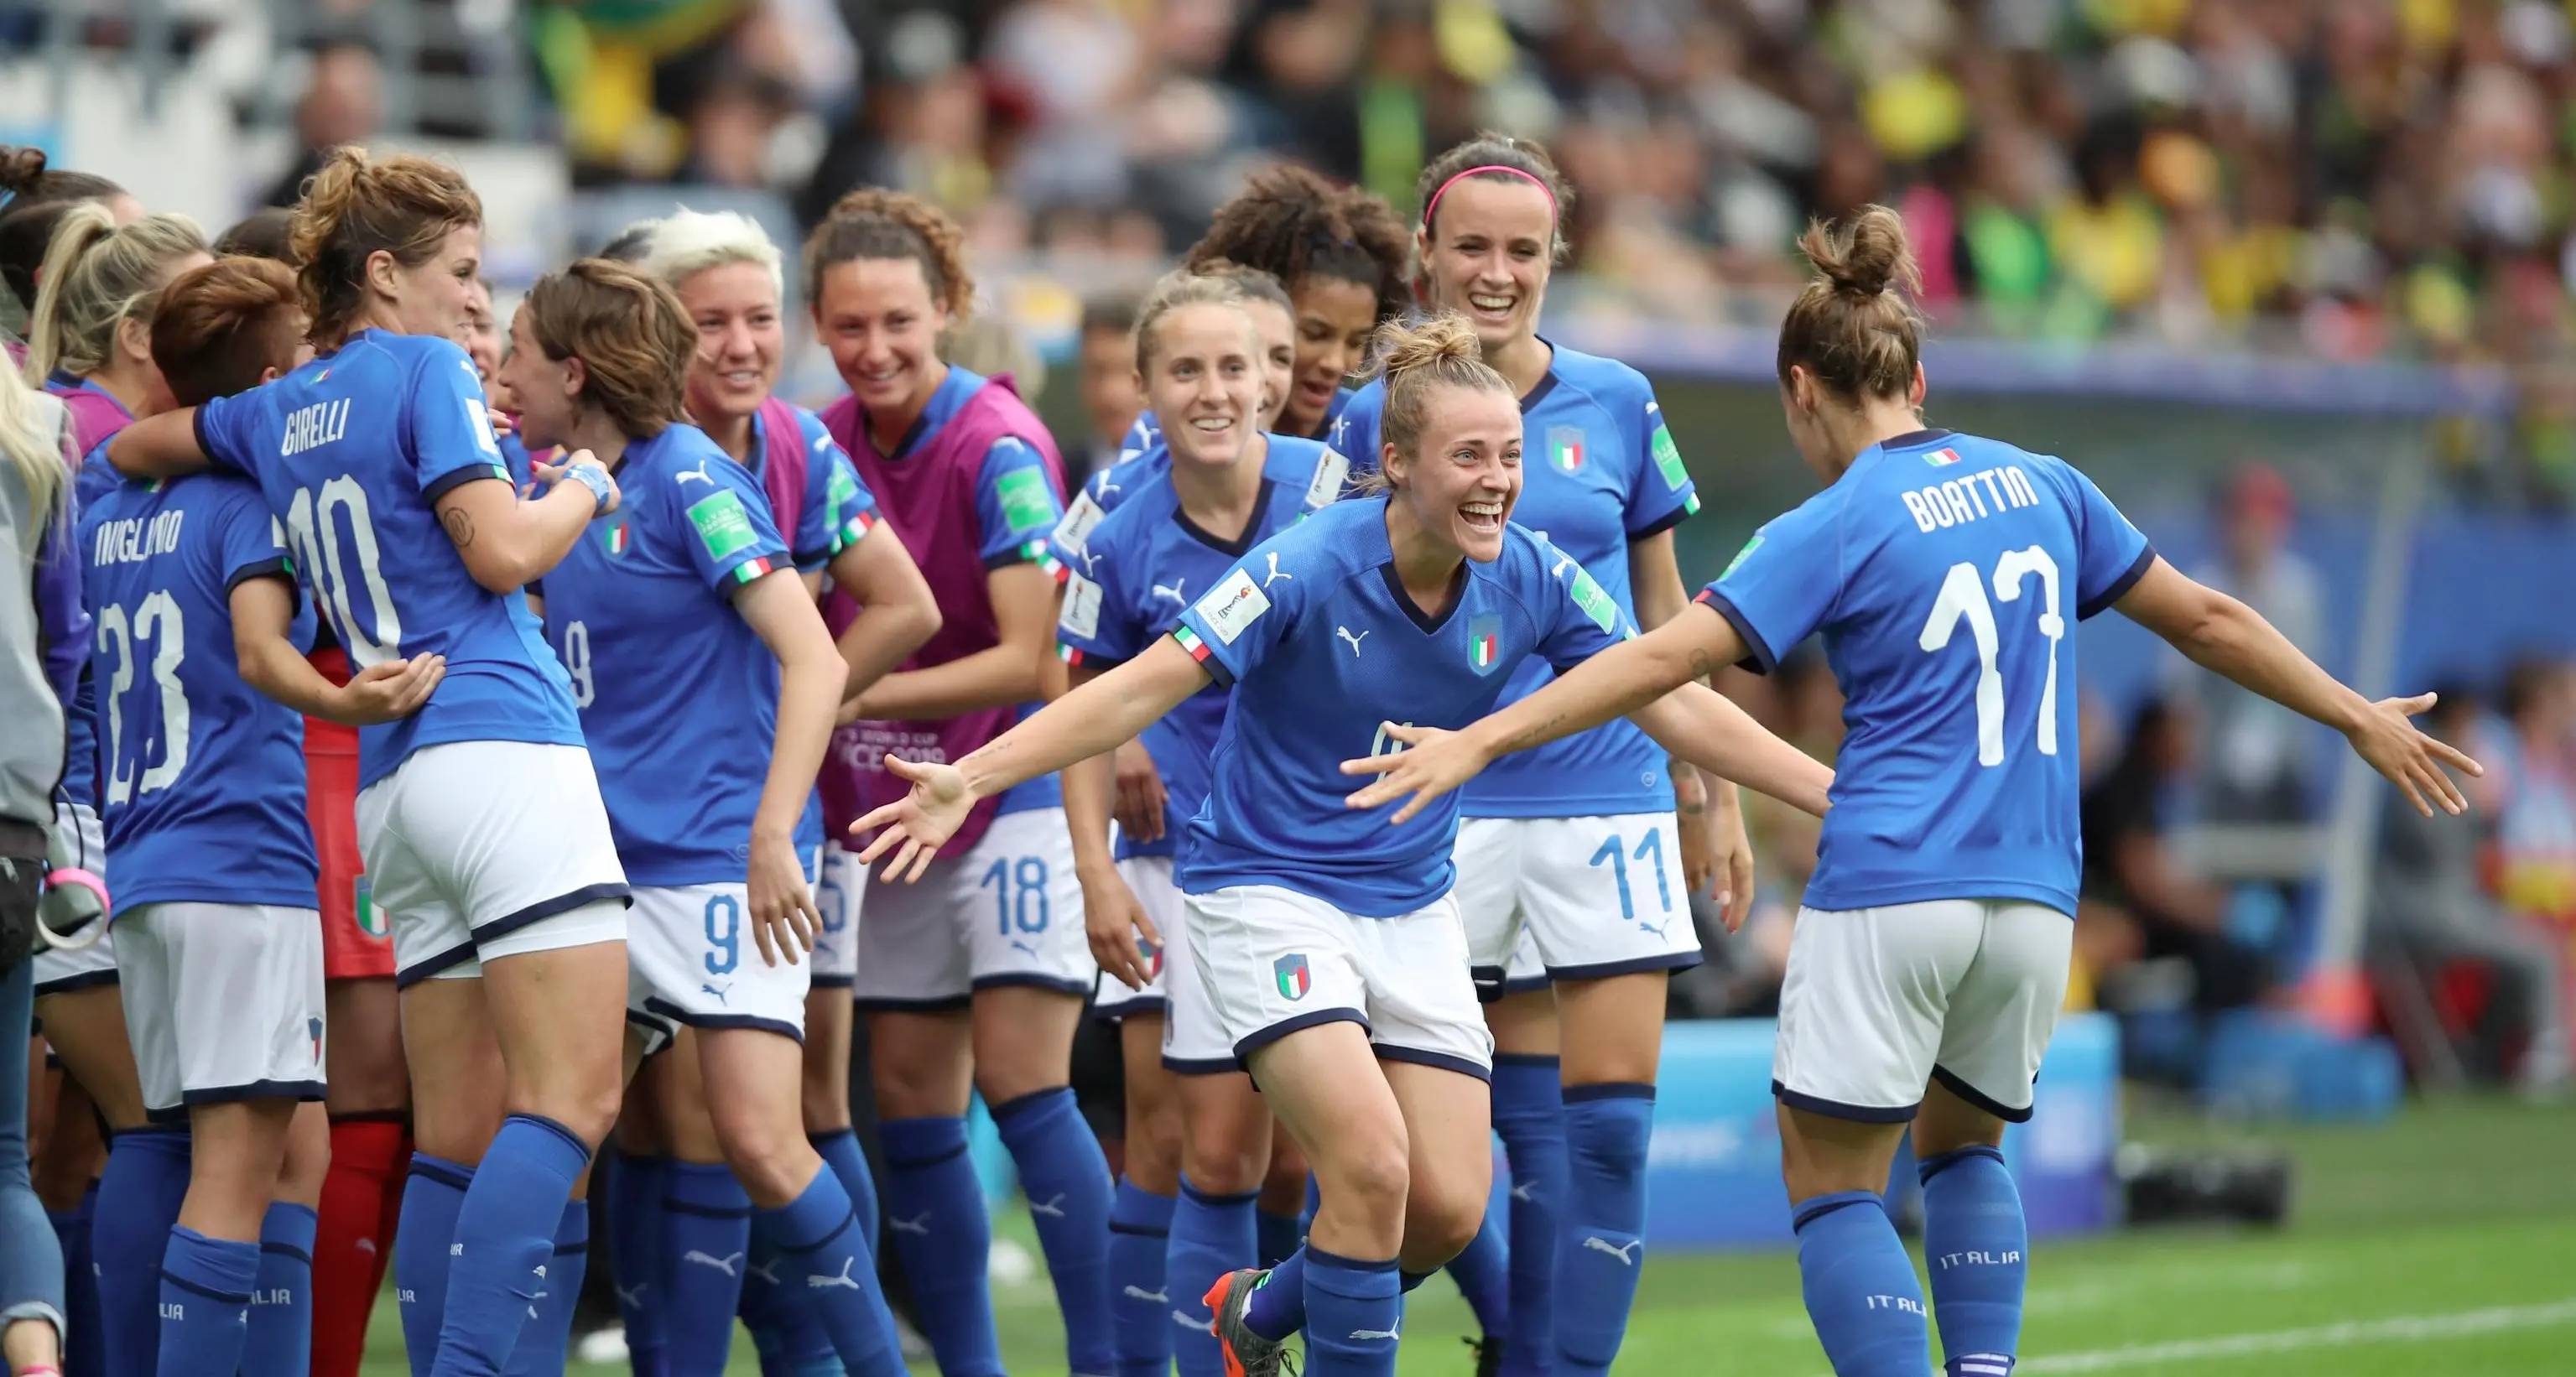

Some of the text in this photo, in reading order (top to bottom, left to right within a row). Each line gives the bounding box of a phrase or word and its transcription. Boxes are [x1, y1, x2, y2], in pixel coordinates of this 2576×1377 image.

[281, 398, 351, 456] GIRELLI
[1902, 465, 2038, 533] BOATTIN
[287, 474, 401, 668] 10
[565, 620, 596, 709] 9
[1919, 544, 2064, 767] 17
[98, 590, 190, 806] 23
[981, 856, 1049, 935] 18
[1589, 827, 1673, 920] 11
[704, 895, 740, 974] 9
[1940, 1250, 2020, 1270] ITALIA
